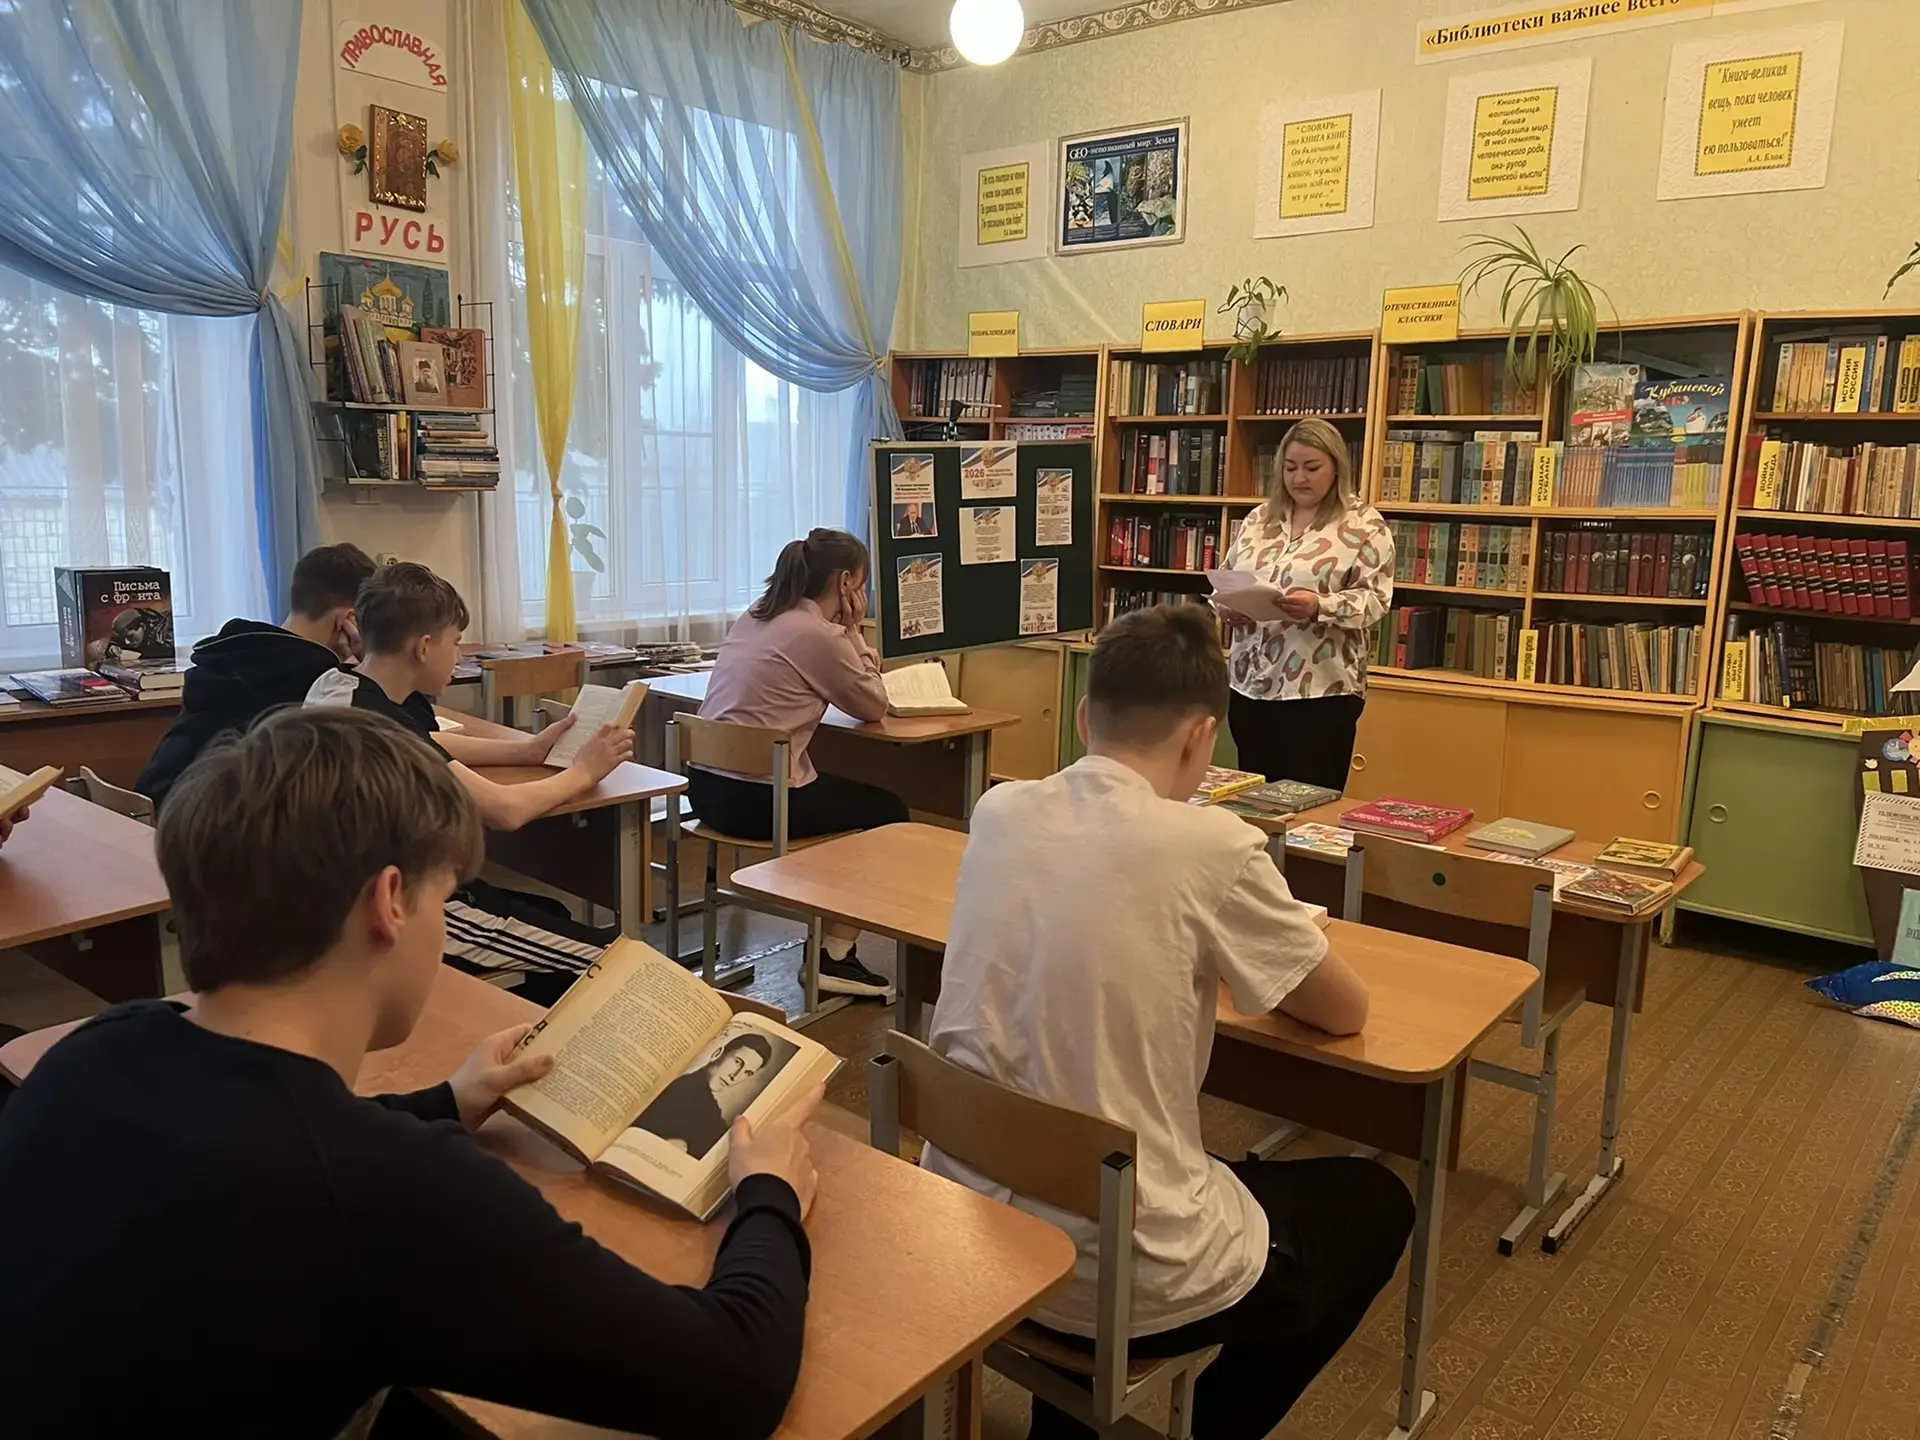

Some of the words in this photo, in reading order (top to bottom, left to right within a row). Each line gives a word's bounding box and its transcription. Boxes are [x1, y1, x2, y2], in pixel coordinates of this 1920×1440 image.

[1426, 15, 1544, 47] «Библиотеки
[1551, 0, 1621, 25] важнее
[340, 24, 447, 87] ПРАВОСЛАВНАЯ
[1734, 92, 1756, 106] пока
[1757, 89, 1794, 103] человек
[1501, 117, 1526, 126] Книга
[1731, 116, 1762, 134] умеет
[1300, 134, 1325, 145] КНИГА
[1491, 137, 1507, 145] ней
[1703, 144, 1716, 155] ею
[1763, 153, 1784, 162] Блок
[356, 212, 445, 253] РУСЬ
[1384, 299, 1458, 312] ОТЕЧЕСТВЕННЫЕ
[1144, 318, 1202, 332] СЛОВАРИ
[1397, 313, 1444, 324] КЛАССИКИ
[1841, 357, 1852, 402] ИСТОРИЯ
[1848, 360, 1859, 400] РОССИИ
[964, 468, 985, 478] 2026
[1537, 455, 1545, 502] РОДНАЯ
[1760, 460, 1769, 491] ВОЙНА
[1767, 453, 1777, 490] ПОБЕДА
[113, 580, 161, 592] Письма
[100, 593, 108, 603] с
